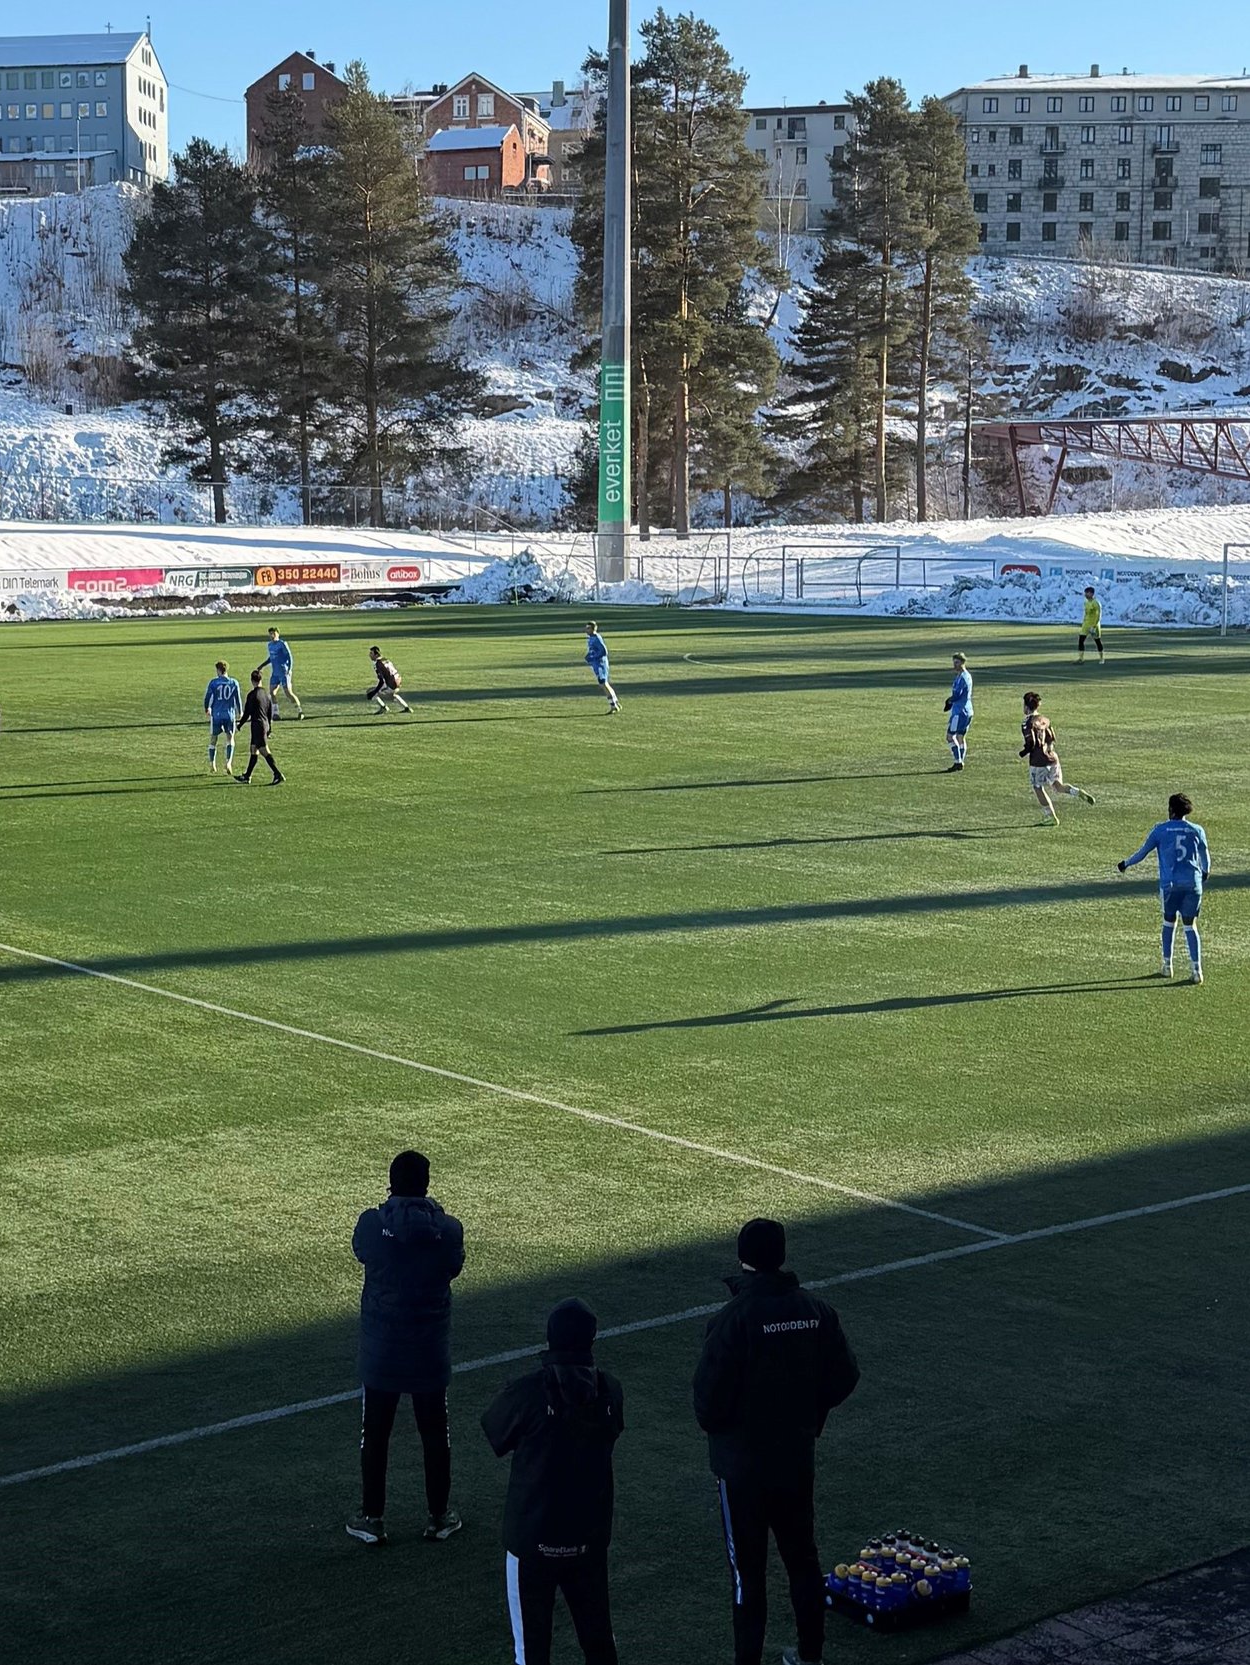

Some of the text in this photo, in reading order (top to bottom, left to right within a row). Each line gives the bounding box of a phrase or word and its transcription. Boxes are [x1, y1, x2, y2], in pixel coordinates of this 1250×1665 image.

[603, 419, 621, 502] everket
[277, 567, 338, 580] 350 22440
[20, 577, 59, 588] Telemark
[169, 575, 194, 587] NRG
[216, 684, 231, 700] 10
[1175, 834, 1188, 862] 5
